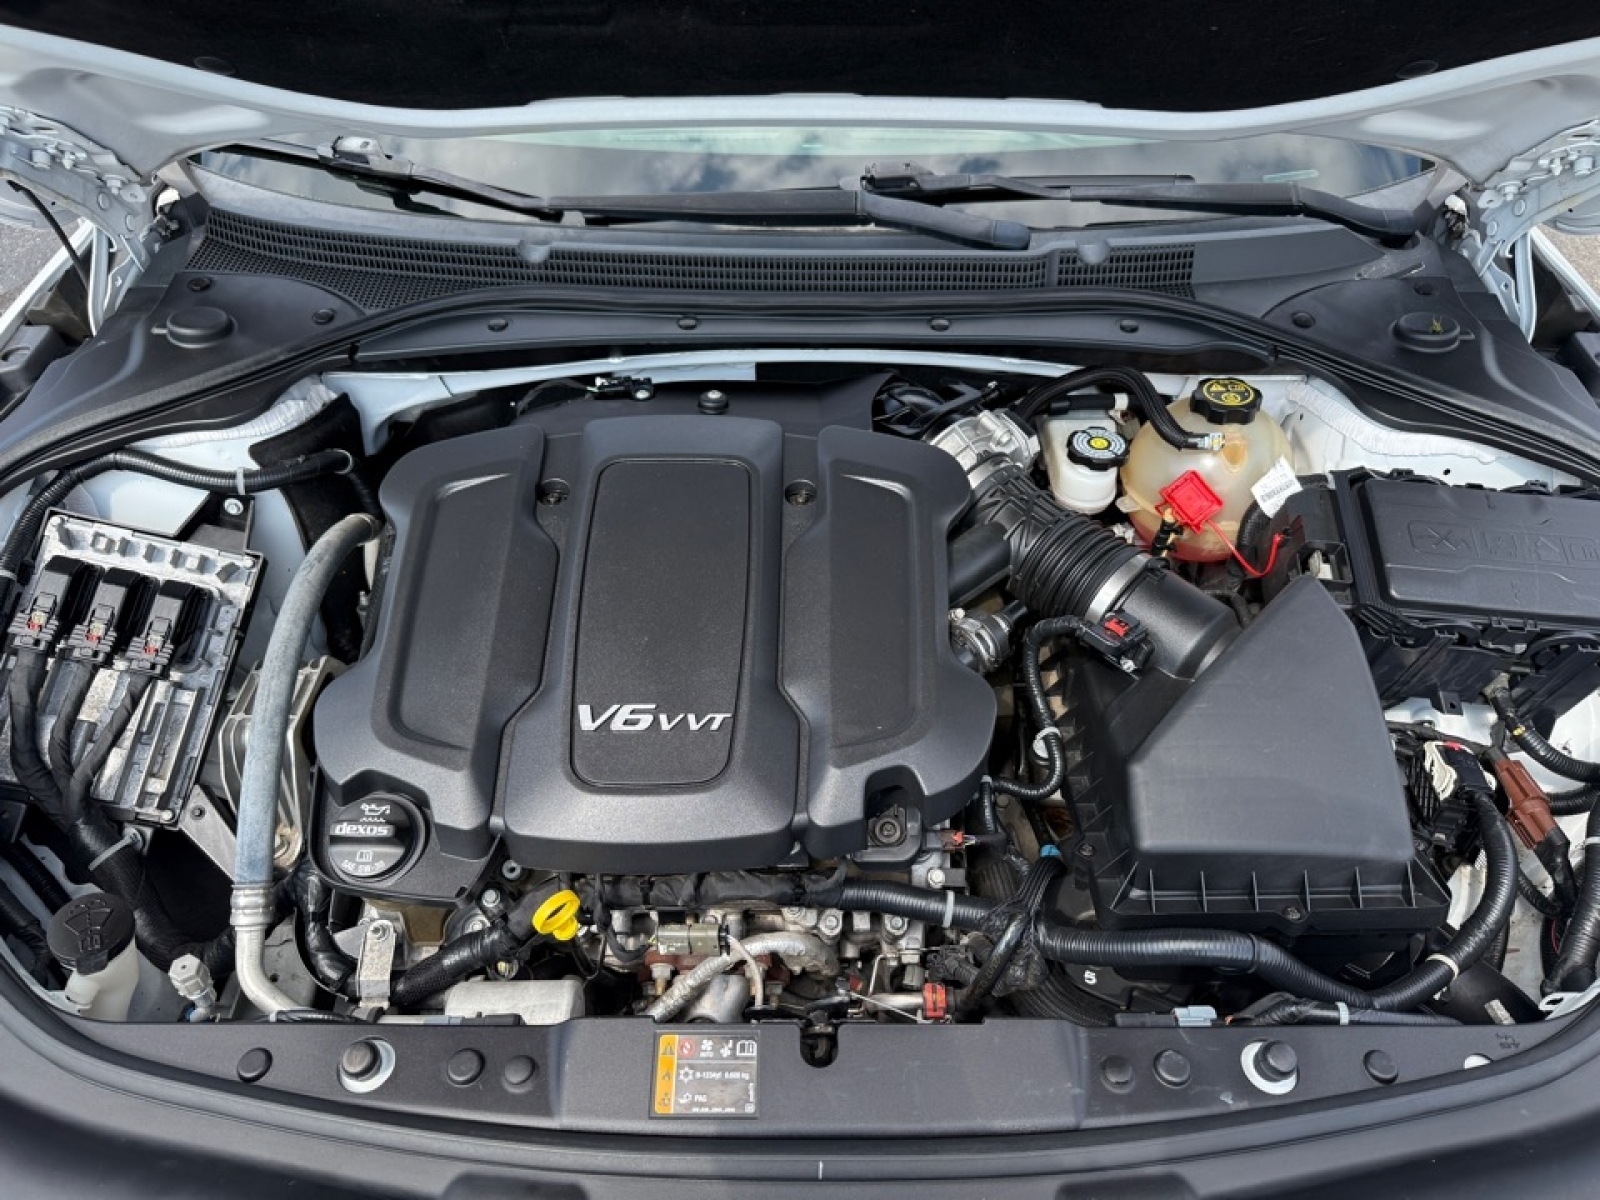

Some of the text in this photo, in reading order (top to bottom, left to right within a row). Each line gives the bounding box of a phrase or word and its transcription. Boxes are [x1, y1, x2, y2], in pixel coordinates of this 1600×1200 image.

[577, 704, 732, 731] V6 VVT
[334, 822, 388, 835] dexos
